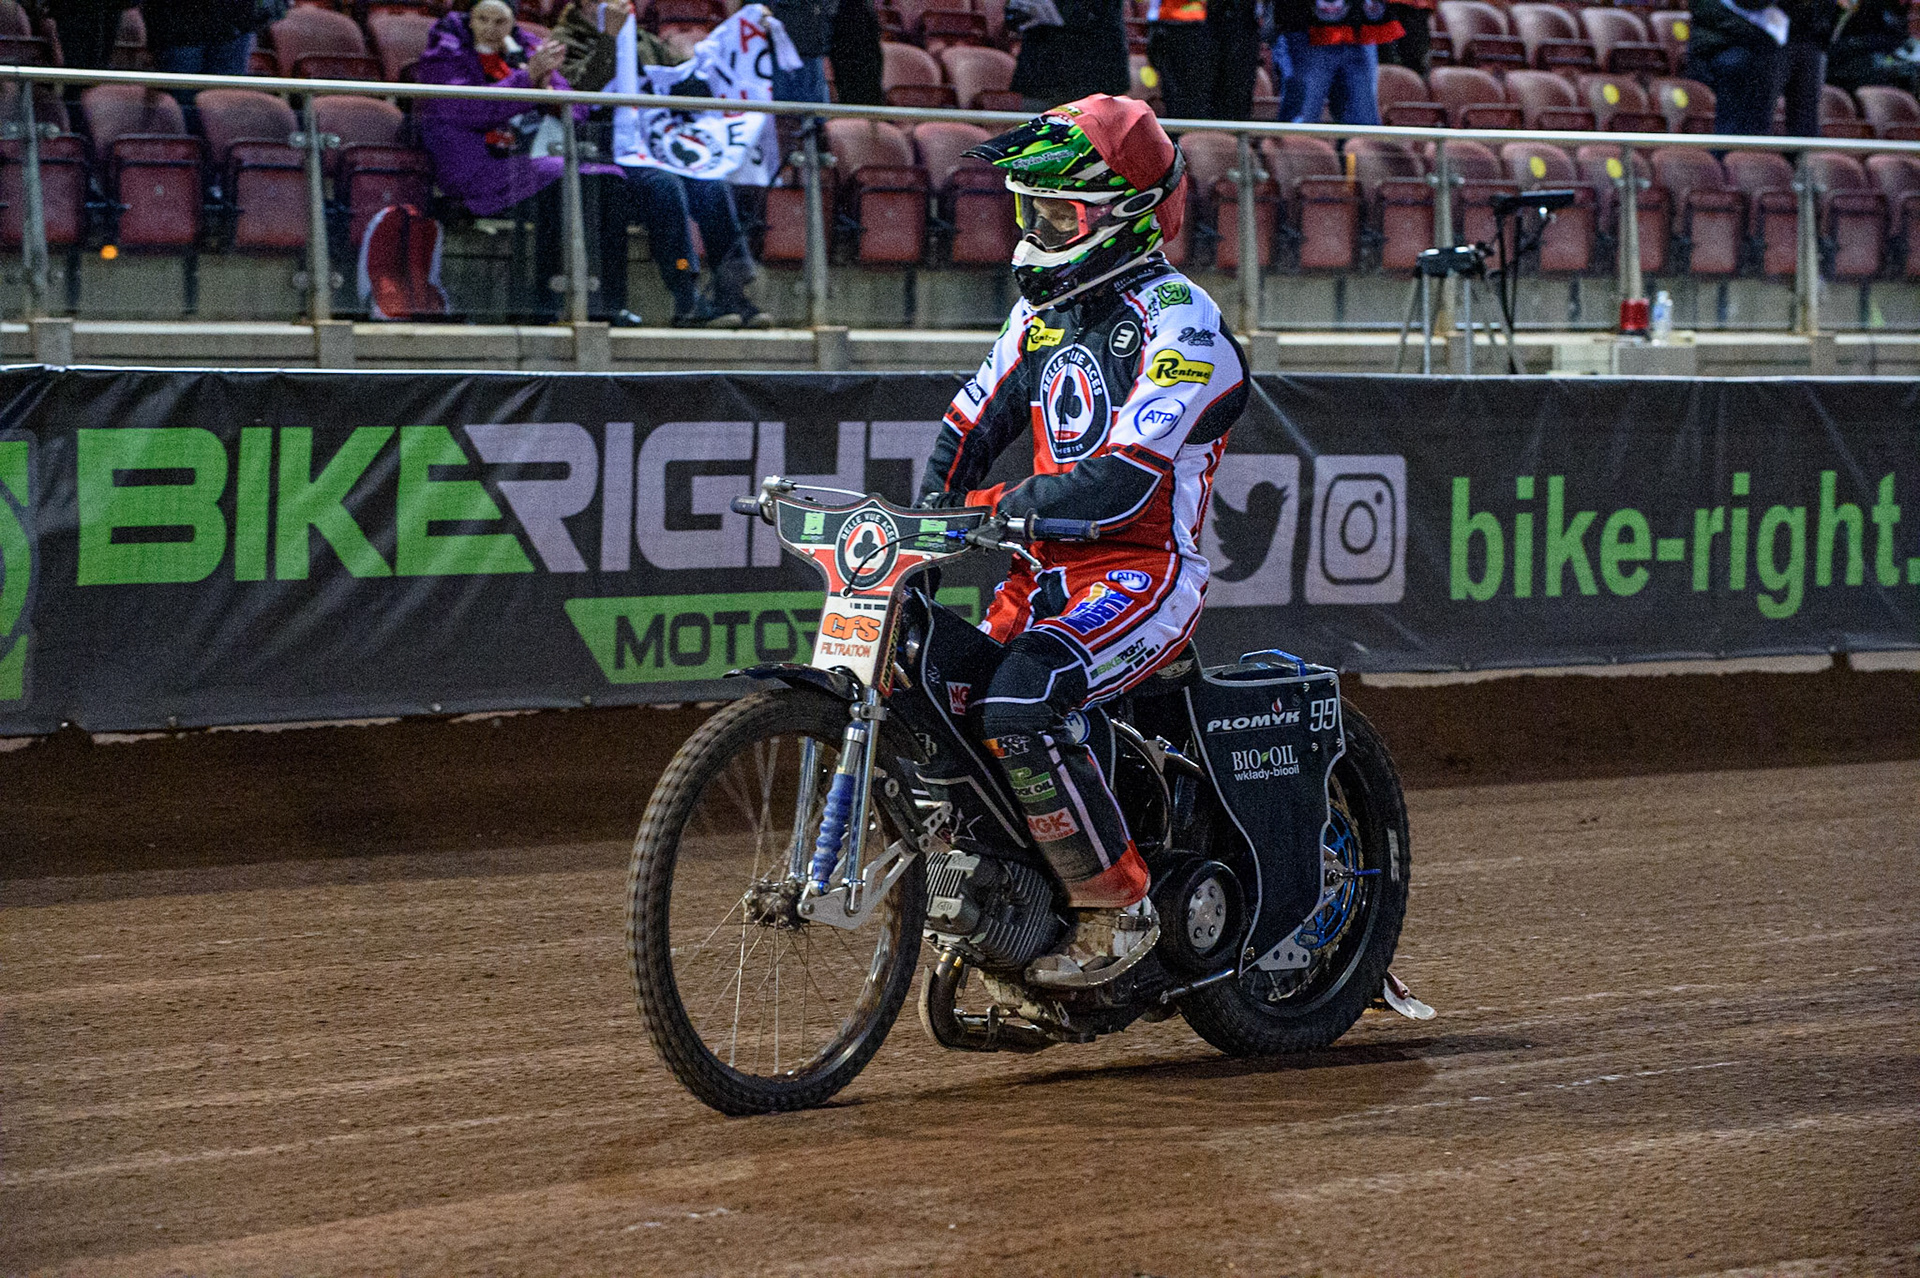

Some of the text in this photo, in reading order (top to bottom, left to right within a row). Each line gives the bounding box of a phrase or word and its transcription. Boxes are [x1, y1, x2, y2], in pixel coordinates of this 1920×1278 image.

[1067, 351, 1085, 366] UE
[1084, 363, 1102, 396] ACES
[841, 515, 863, 540] BELLE
[864, 513, 881, 523] VUE
[822, 612, 881, 642] CFS
[821, 641, 871, 658] FILTRATION
[1309, 698, 1337, 732] 99
